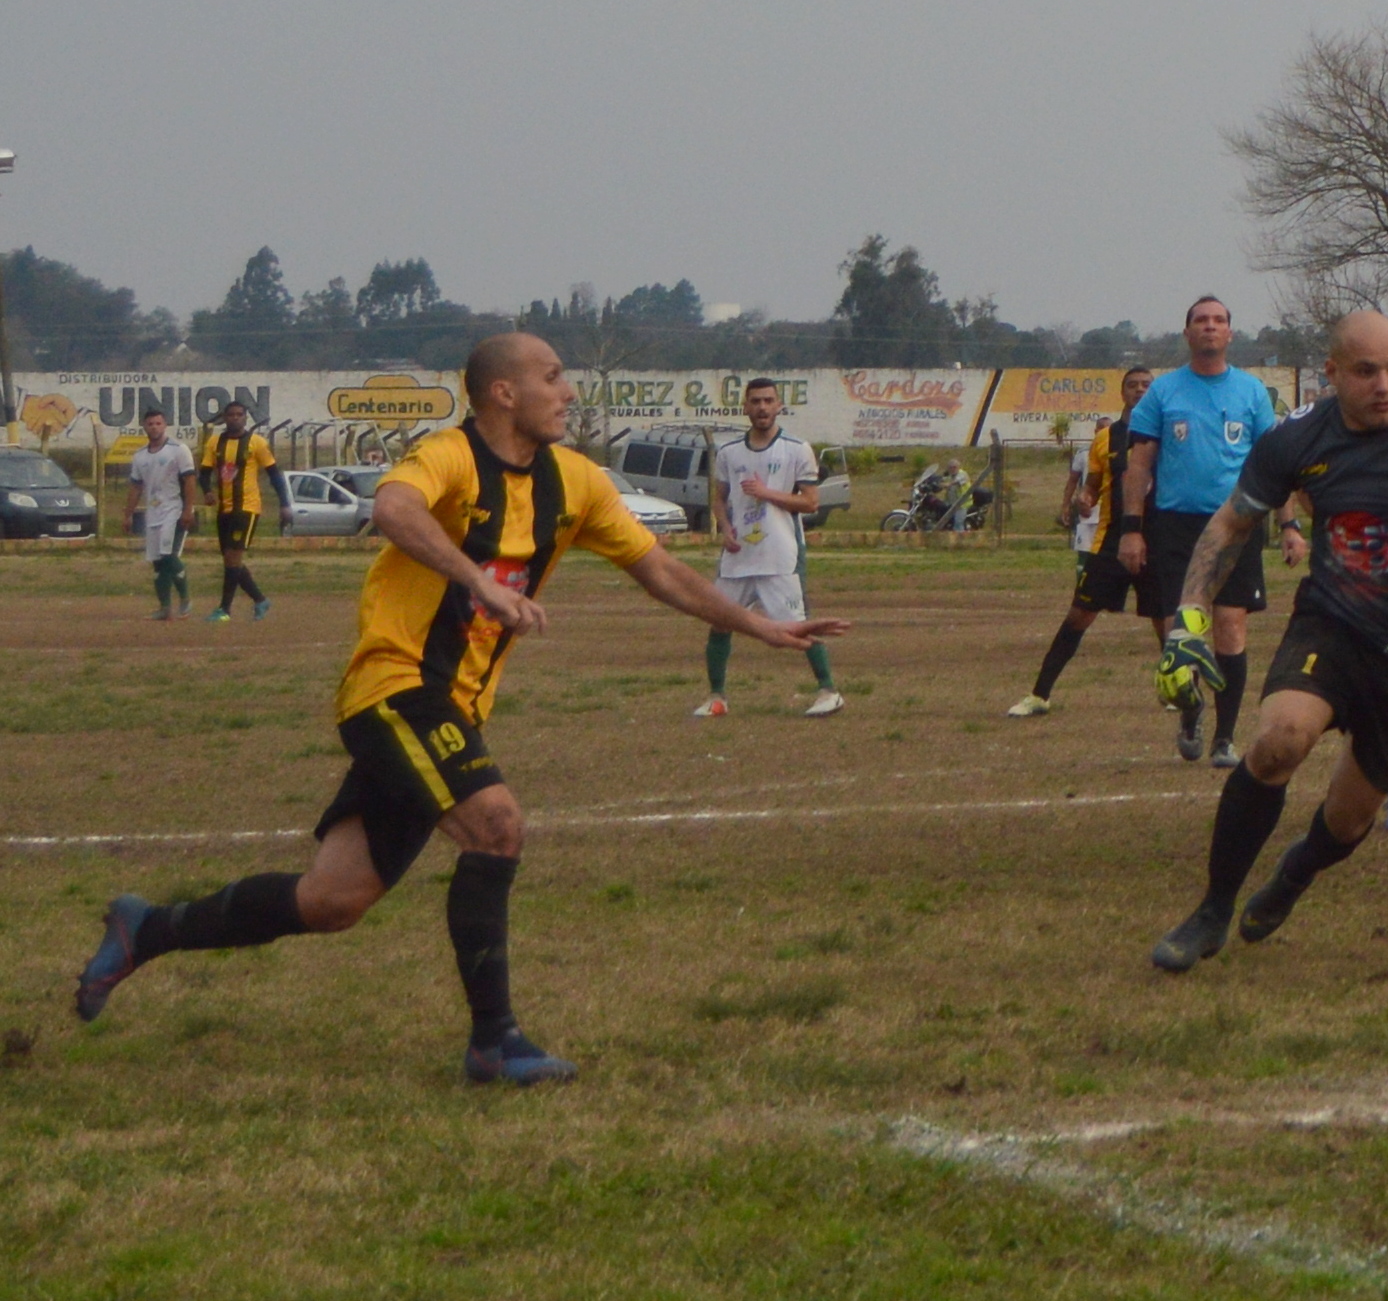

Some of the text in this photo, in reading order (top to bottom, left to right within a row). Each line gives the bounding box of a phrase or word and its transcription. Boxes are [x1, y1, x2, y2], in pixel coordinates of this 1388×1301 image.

[59, 374, 158, 384] DISTRIBUIDORA
[841, 370, 966, 402] Cardozo
[1040, 378, 1106, 394] CARLOS
[577, 375, 808, 408] VAREZ & GTE
[100, 386, 270, 427] UNION
[338, 394, 434, 414] Centenario
[609, 407, 663, 418] RURALES
[674, 407, 681, 417] E
[1301, 653, 1318, 675] 1
[429, 721, 466, 761] 19
